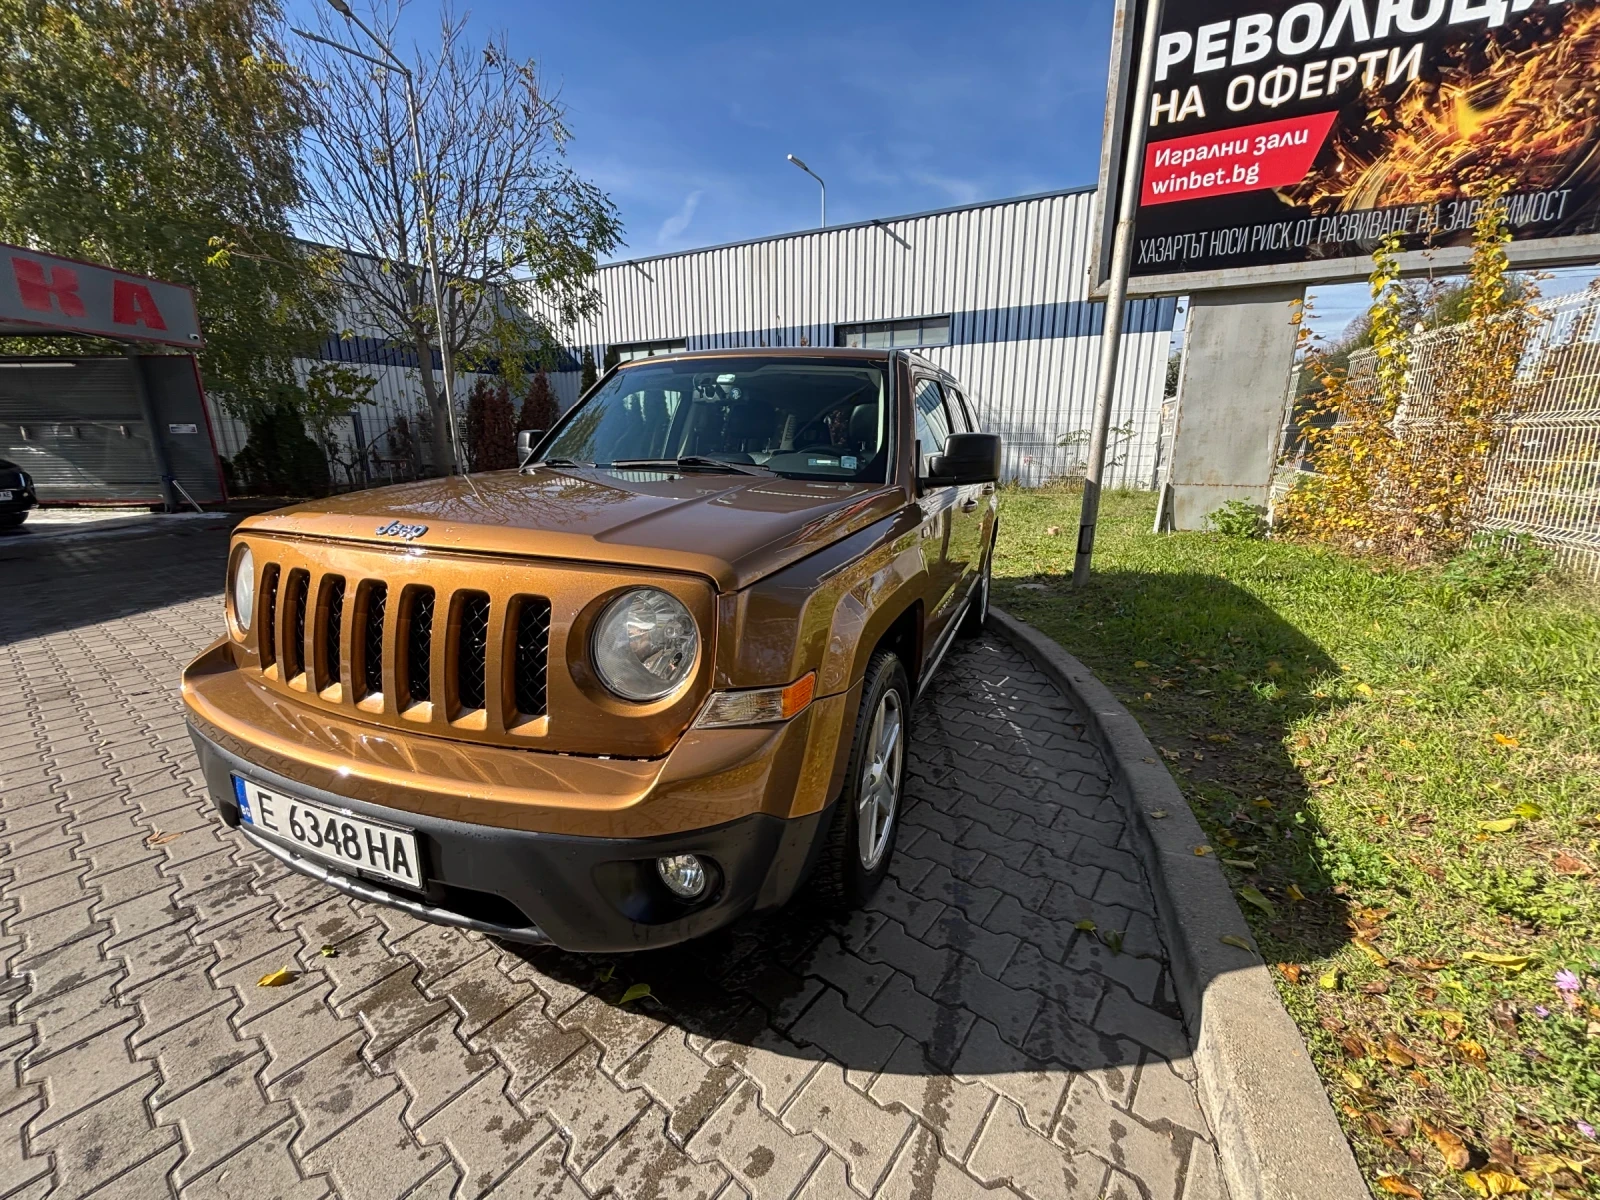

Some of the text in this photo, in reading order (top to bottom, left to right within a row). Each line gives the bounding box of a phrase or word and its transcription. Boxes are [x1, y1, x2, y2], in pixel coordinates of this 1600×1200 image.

[1154, 0, 1565, 82] РЕВОЛЮЦ
[1149, 42, 1424, 126] НА ОФЕРТИ
[1152, 162, 1260, 195] winbet.bg
[1154, 128, 1309, 168] Игрални зали
[1138, 189, 1572, 265] ХАЗАРТЪТ НОСИ РИСК ОТ РАЗВИВАНЕ НА ЗАВИМОСТ
[375, 519, 430, 541] Jeep
[256, 790, 413, 880] E 6348 HA
